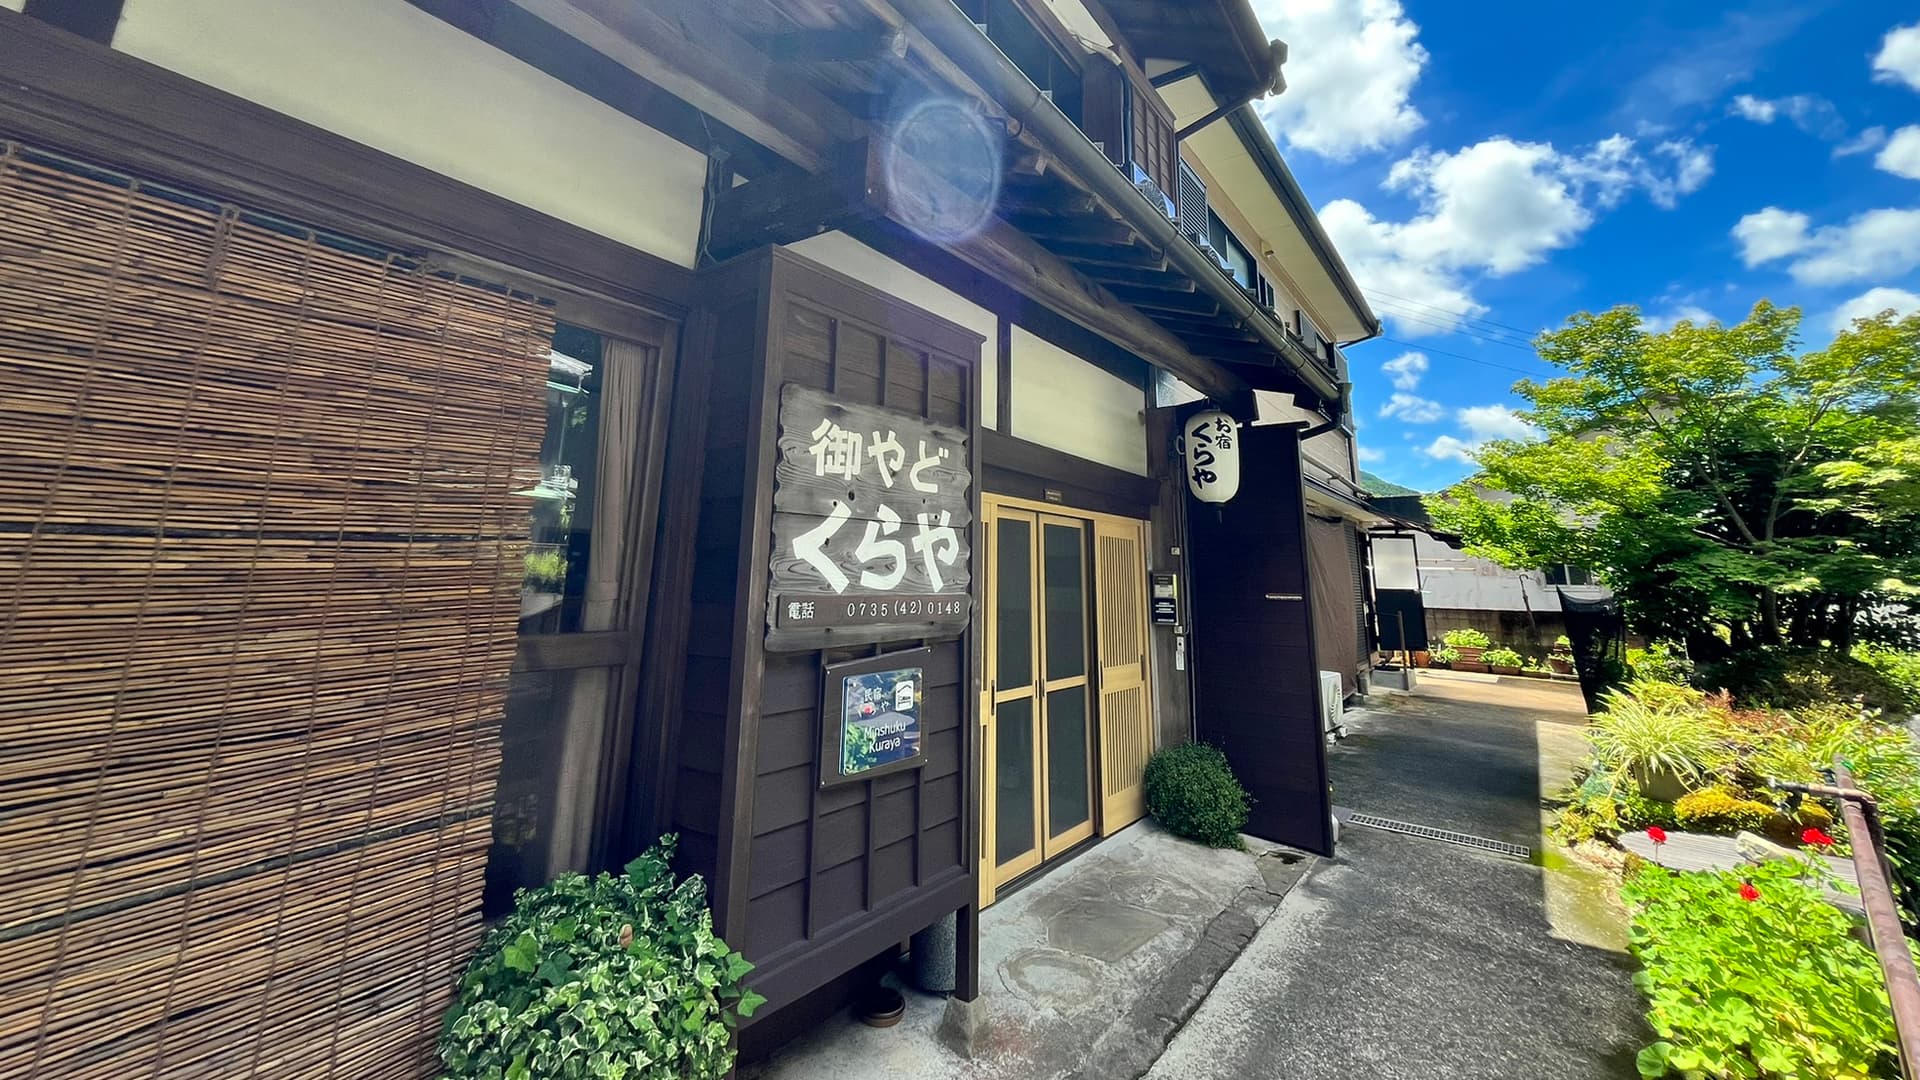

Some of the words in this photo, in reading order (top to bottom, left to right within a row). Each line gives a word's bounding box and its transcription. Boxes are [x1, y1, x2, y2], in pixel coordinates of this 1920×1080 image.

[1215, 417, 1232, 449] お宿
[808, 418, 949, 493] 御やど
[1191, 422, 1217, 489] くらや
[792, 500, 959, 594] くらや
[788, 602, 815, 619] 電話
[863, 721, 906, 741] Minshuku
[868, 737, 901, 754] Kuraya
